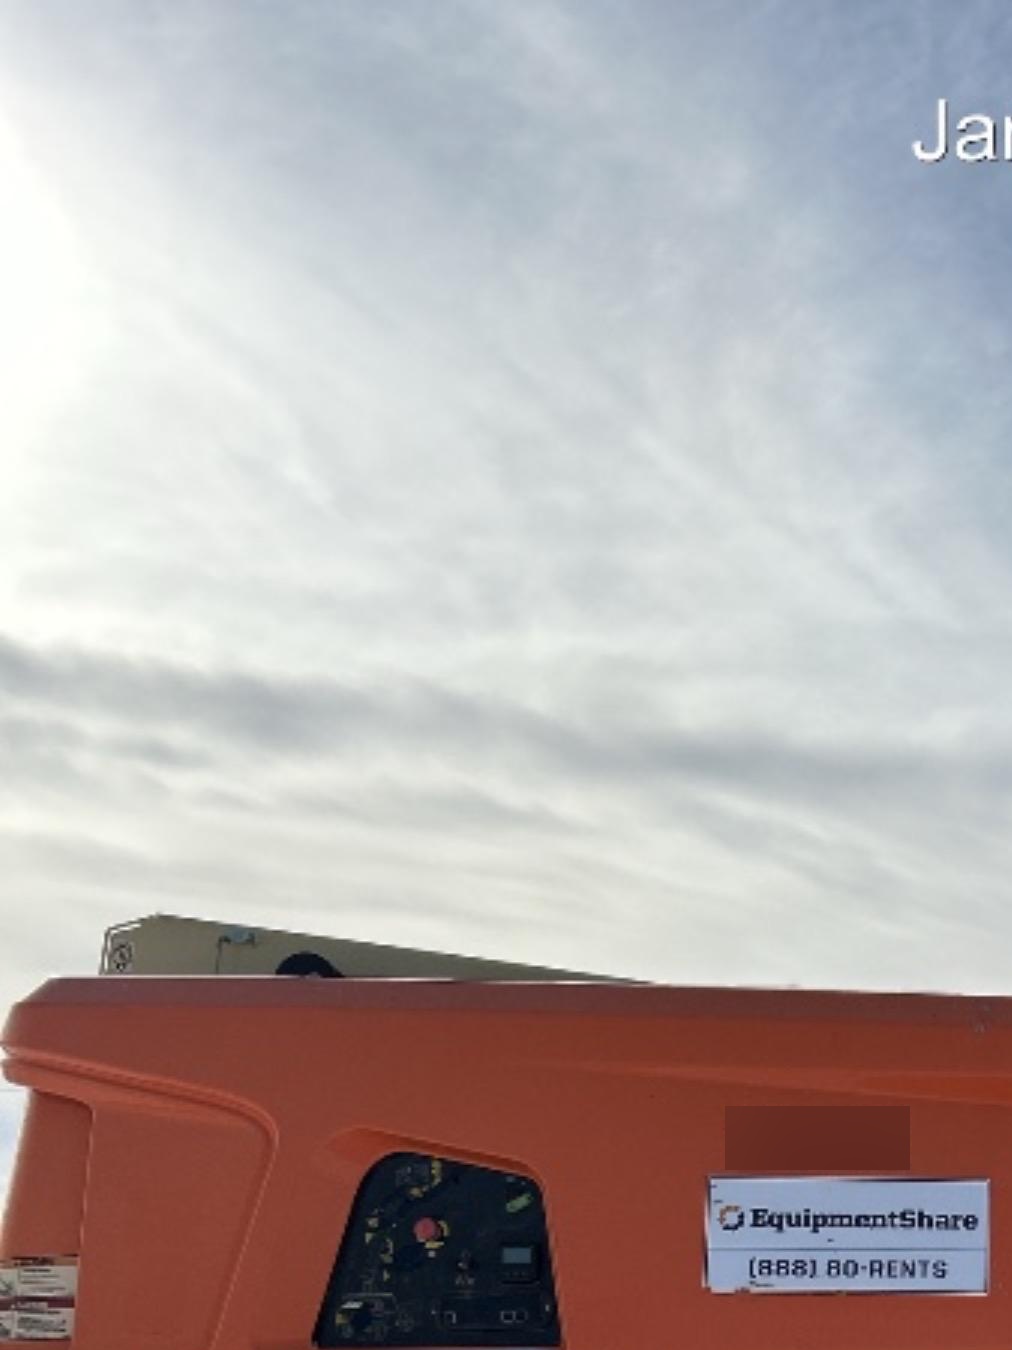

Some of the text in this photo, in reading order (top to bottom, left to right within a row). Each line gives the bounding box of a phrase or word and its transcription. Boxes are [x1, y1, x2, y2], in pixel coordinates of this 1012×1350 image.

[749, 1207, 980, 1233] EquipmentShare
[748, 1257, 949, 1280] (888) 80-RENTS
